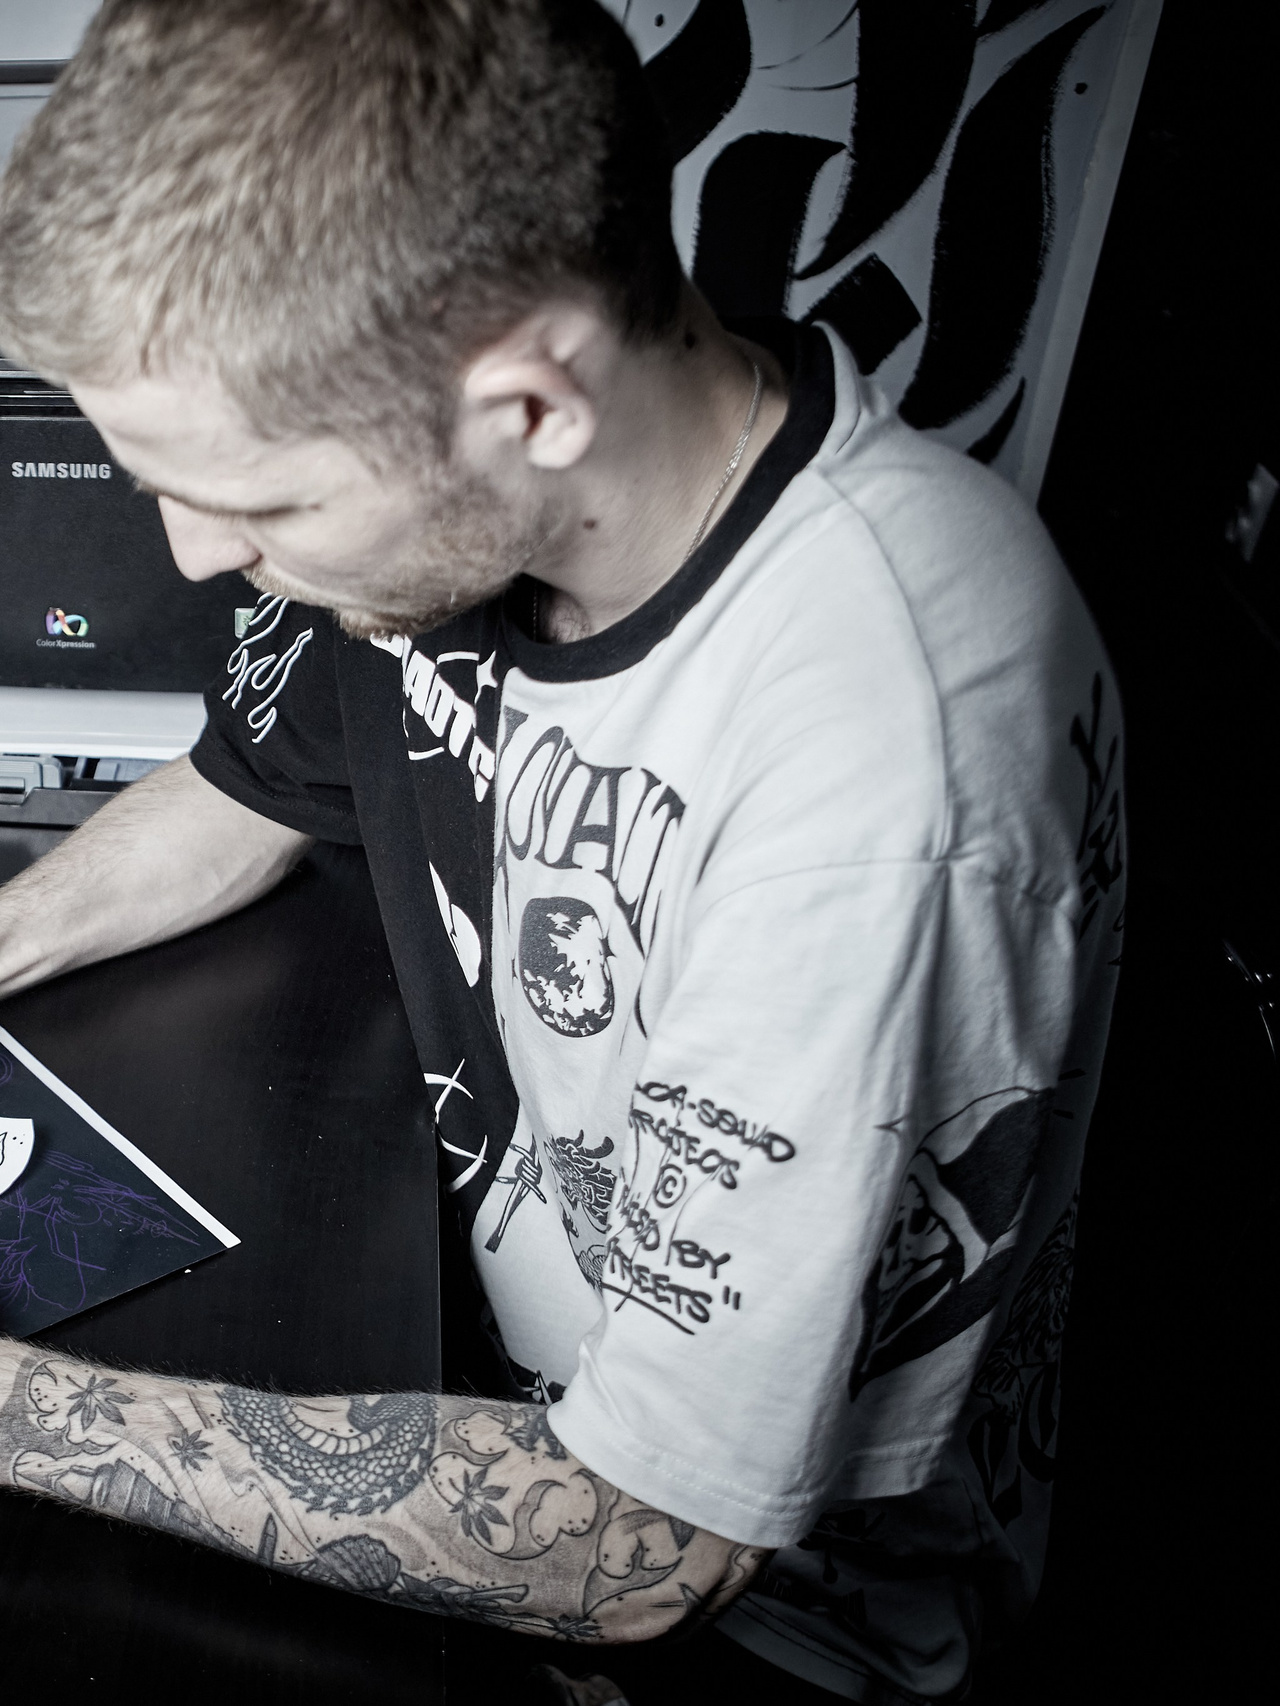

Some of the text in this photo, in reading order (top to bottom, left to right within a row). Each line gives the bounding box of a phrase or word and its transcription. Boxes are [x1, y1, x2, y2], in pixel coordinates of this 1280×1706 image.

[11, 462, 112, 479] SAMSUNG
[36, 638, 95, 649] ColorXpression
[669, 1238, 732, 1280] BY
